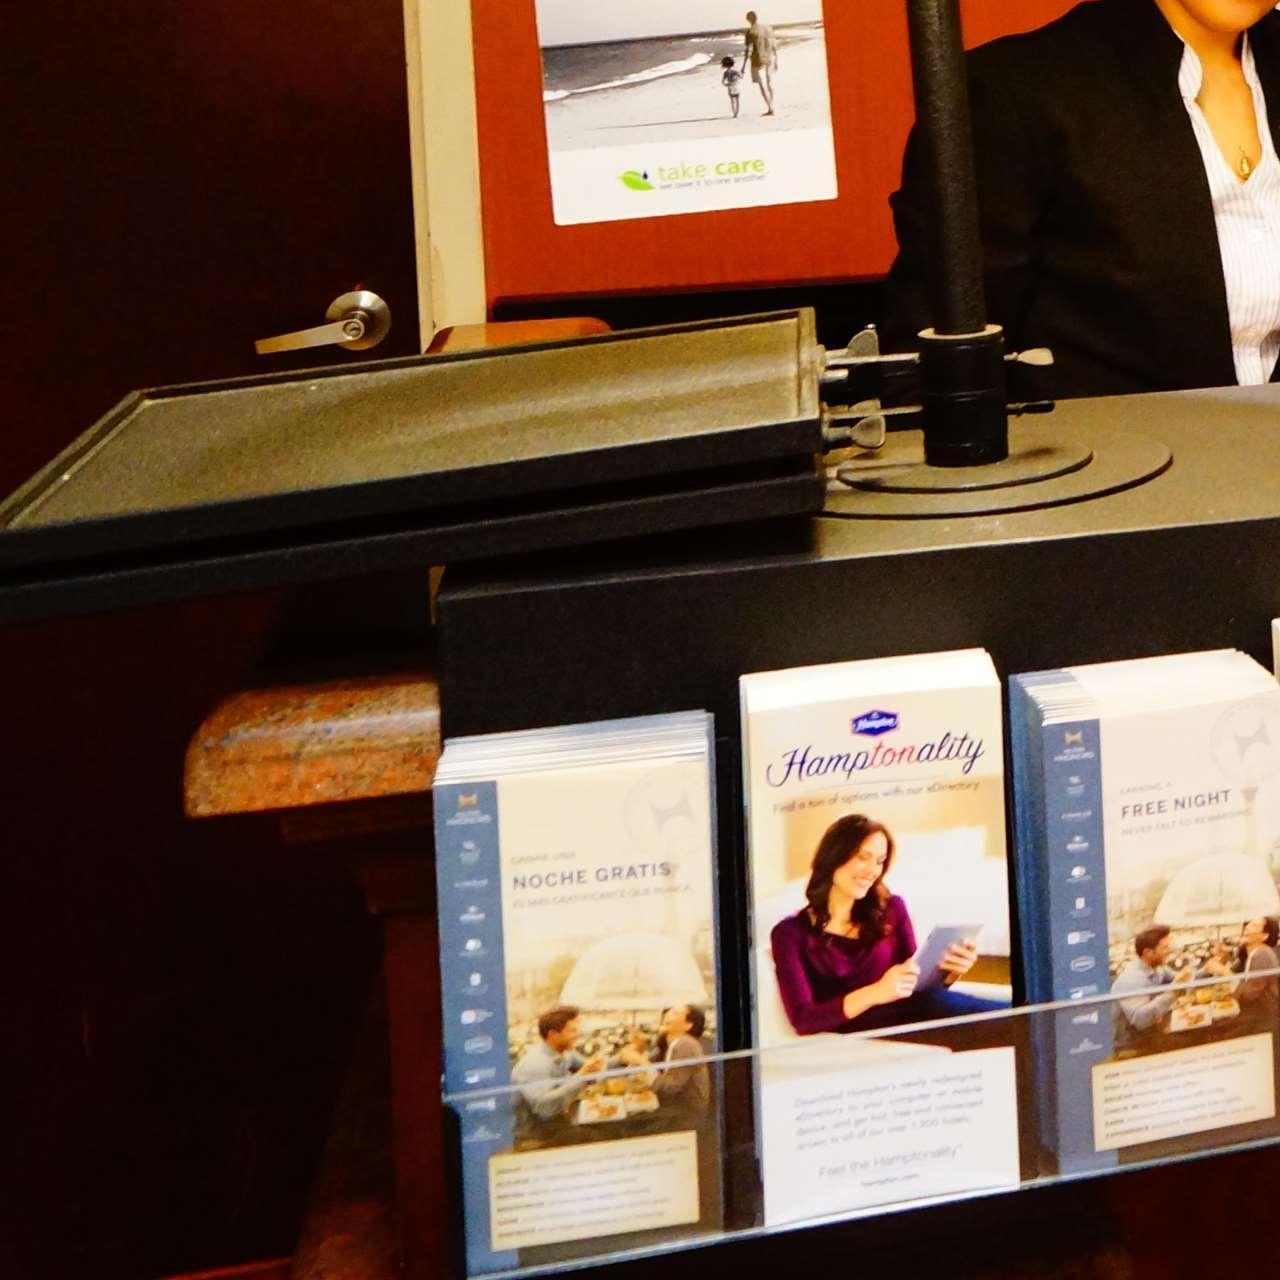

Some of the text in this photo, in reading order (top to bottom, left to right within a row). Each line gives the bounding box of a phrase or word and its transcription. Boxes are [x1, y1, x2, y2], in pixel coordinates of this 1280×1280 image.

[658, 158, 765, 181] take care
[766, 731, 985, 787] Hamptonality
[1121, 789, 1232, 818] FREE NIGHT
[512, 862, 673, 890] NOCHE GRATIS
